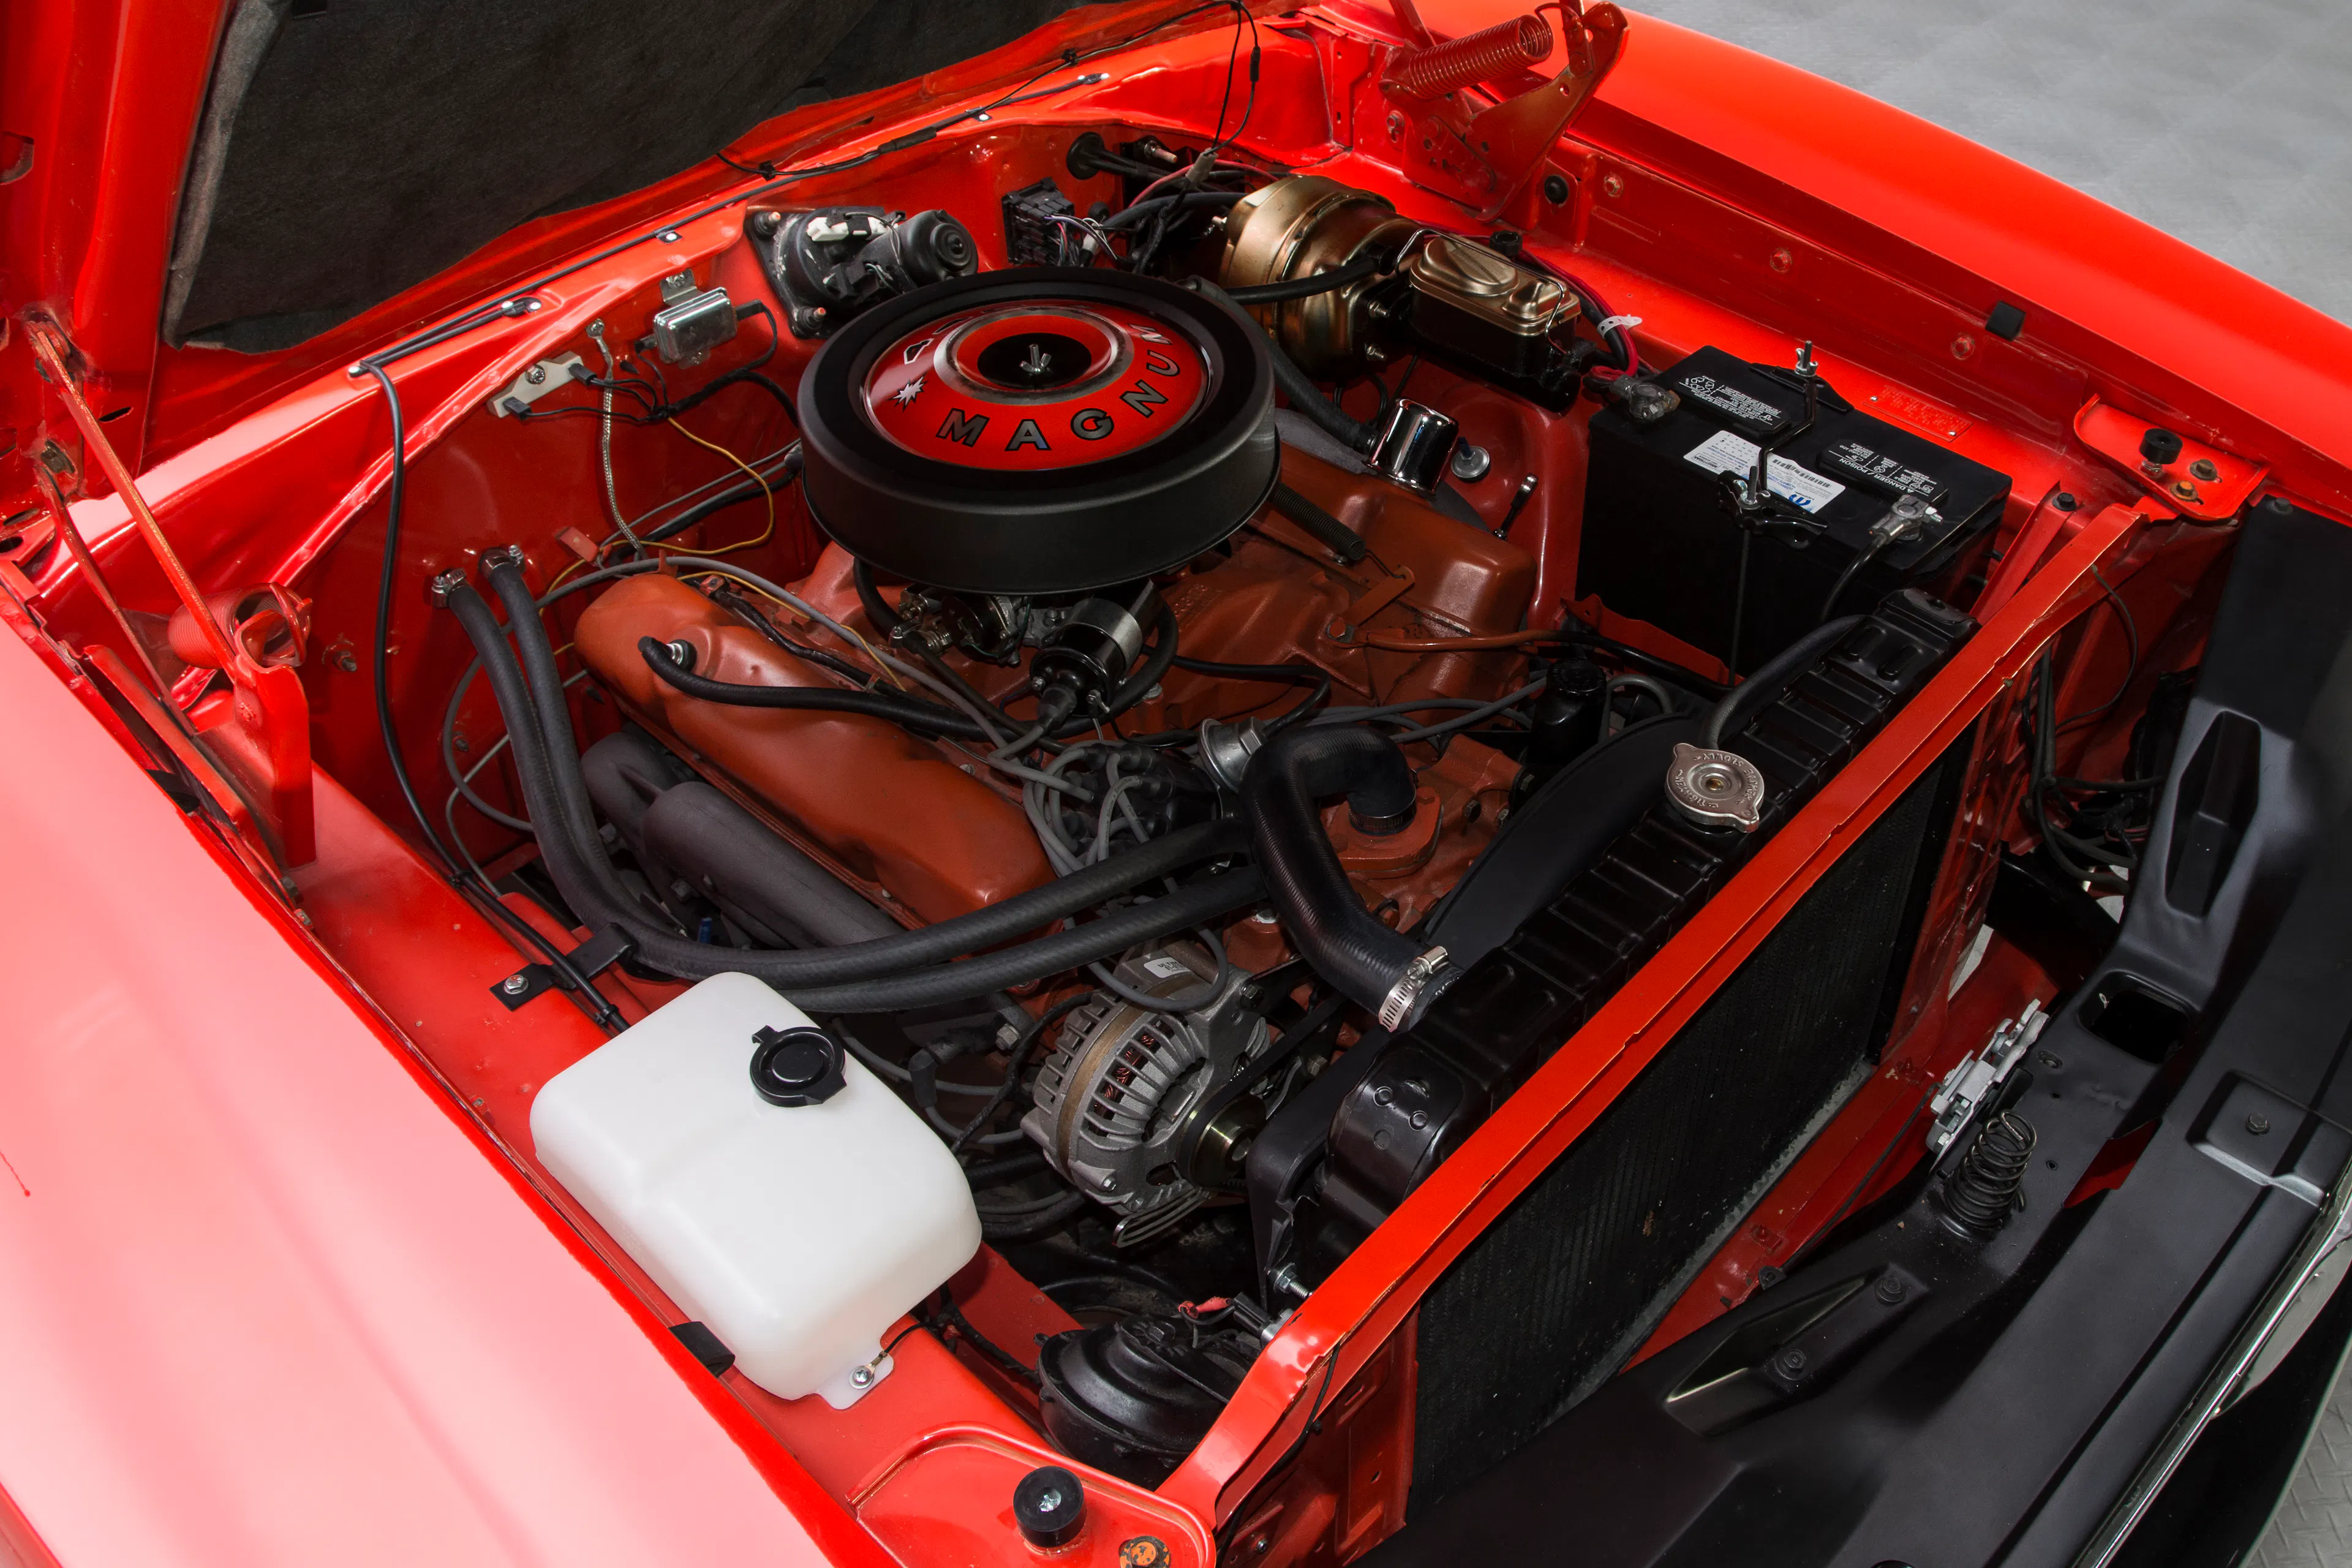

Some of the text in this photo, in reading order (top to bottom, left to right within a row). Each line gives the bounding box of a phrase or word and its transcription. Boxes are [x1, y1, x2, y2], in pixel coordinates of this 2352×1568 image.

[935, 322, 1181, 451] MAGNUM
[1839, 458, 1868, 472] POISON
[1874, 473, 1907, 491] DANGER
[1703, 753, 1744, 767] SLOWLY
